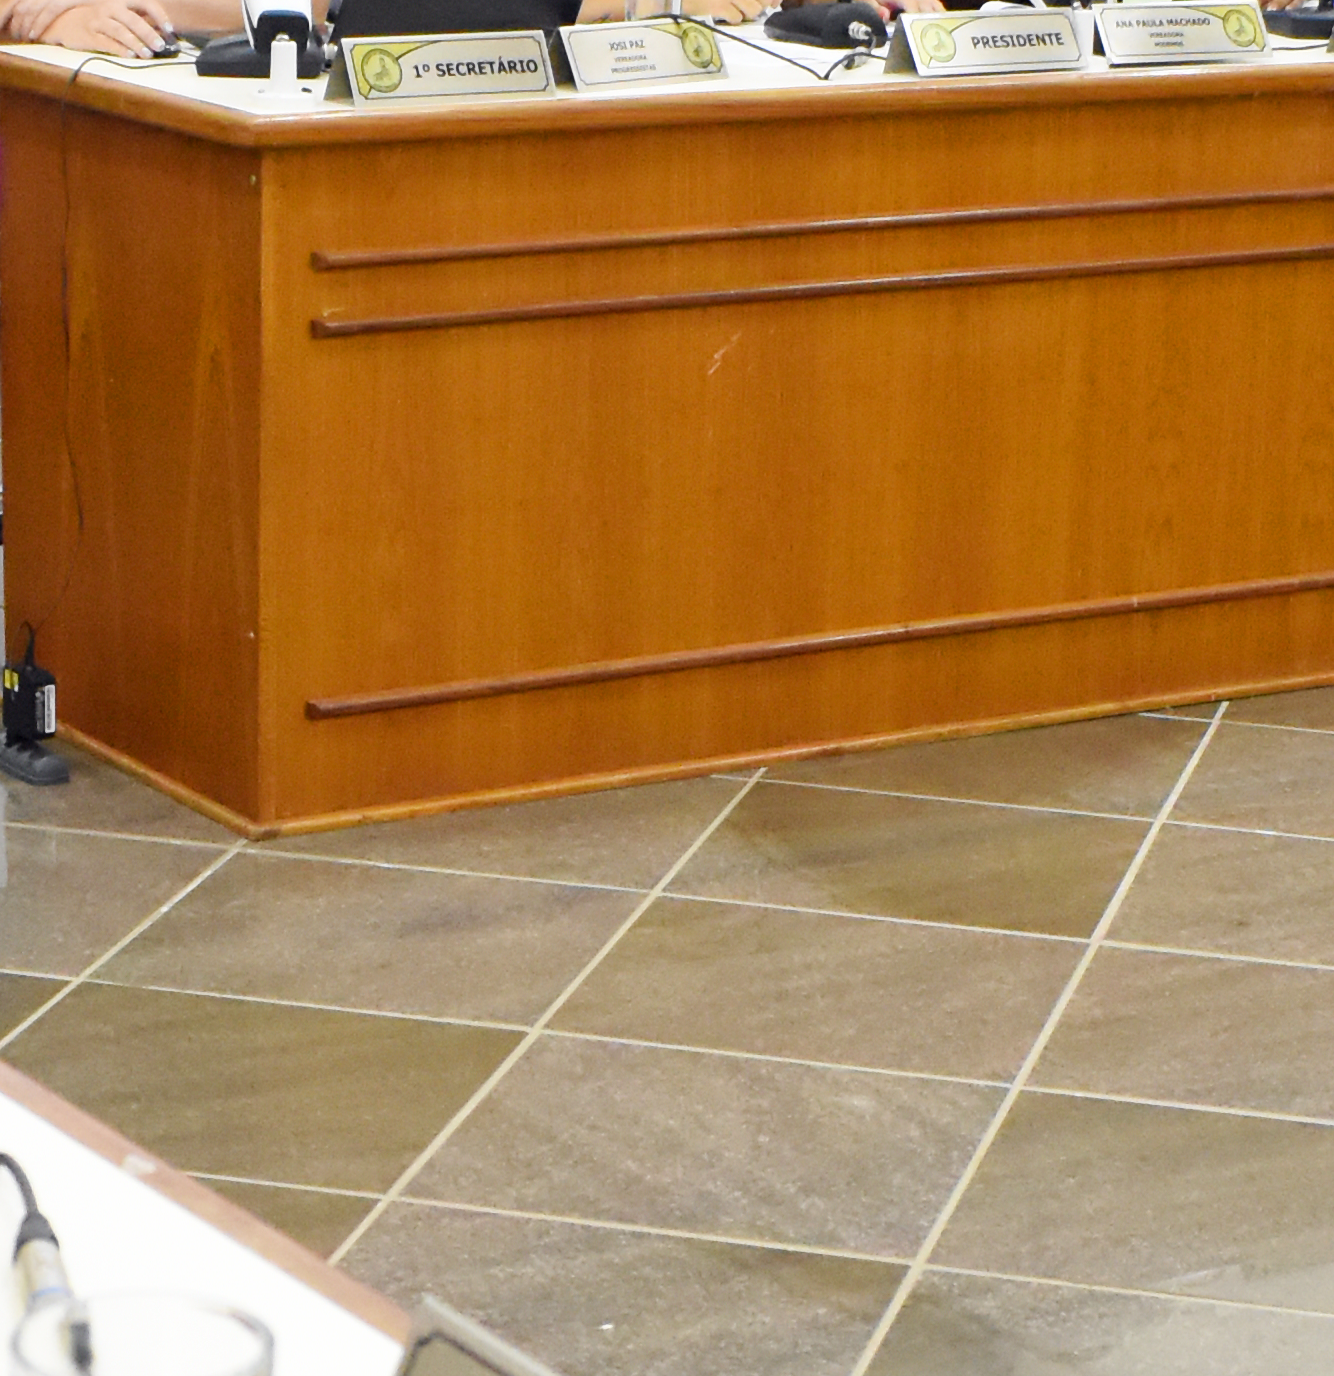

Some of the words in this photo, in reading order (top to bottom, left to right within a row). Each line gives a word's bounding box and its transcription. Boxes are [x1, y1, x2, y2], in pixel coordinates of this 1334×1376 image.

[1115, 19, 1134, 29] ANA
[1135, 18, 1165, 28] PAULA
[1166, 17, 1211, 27] MACHADO
[628, 39, 646, 49] PAZ
[970, 32, 1065, 50] PRESIDENTE
[412, 63, 431, 79] 1º
[435, 55, 539, 78] SECRETÁRIO
